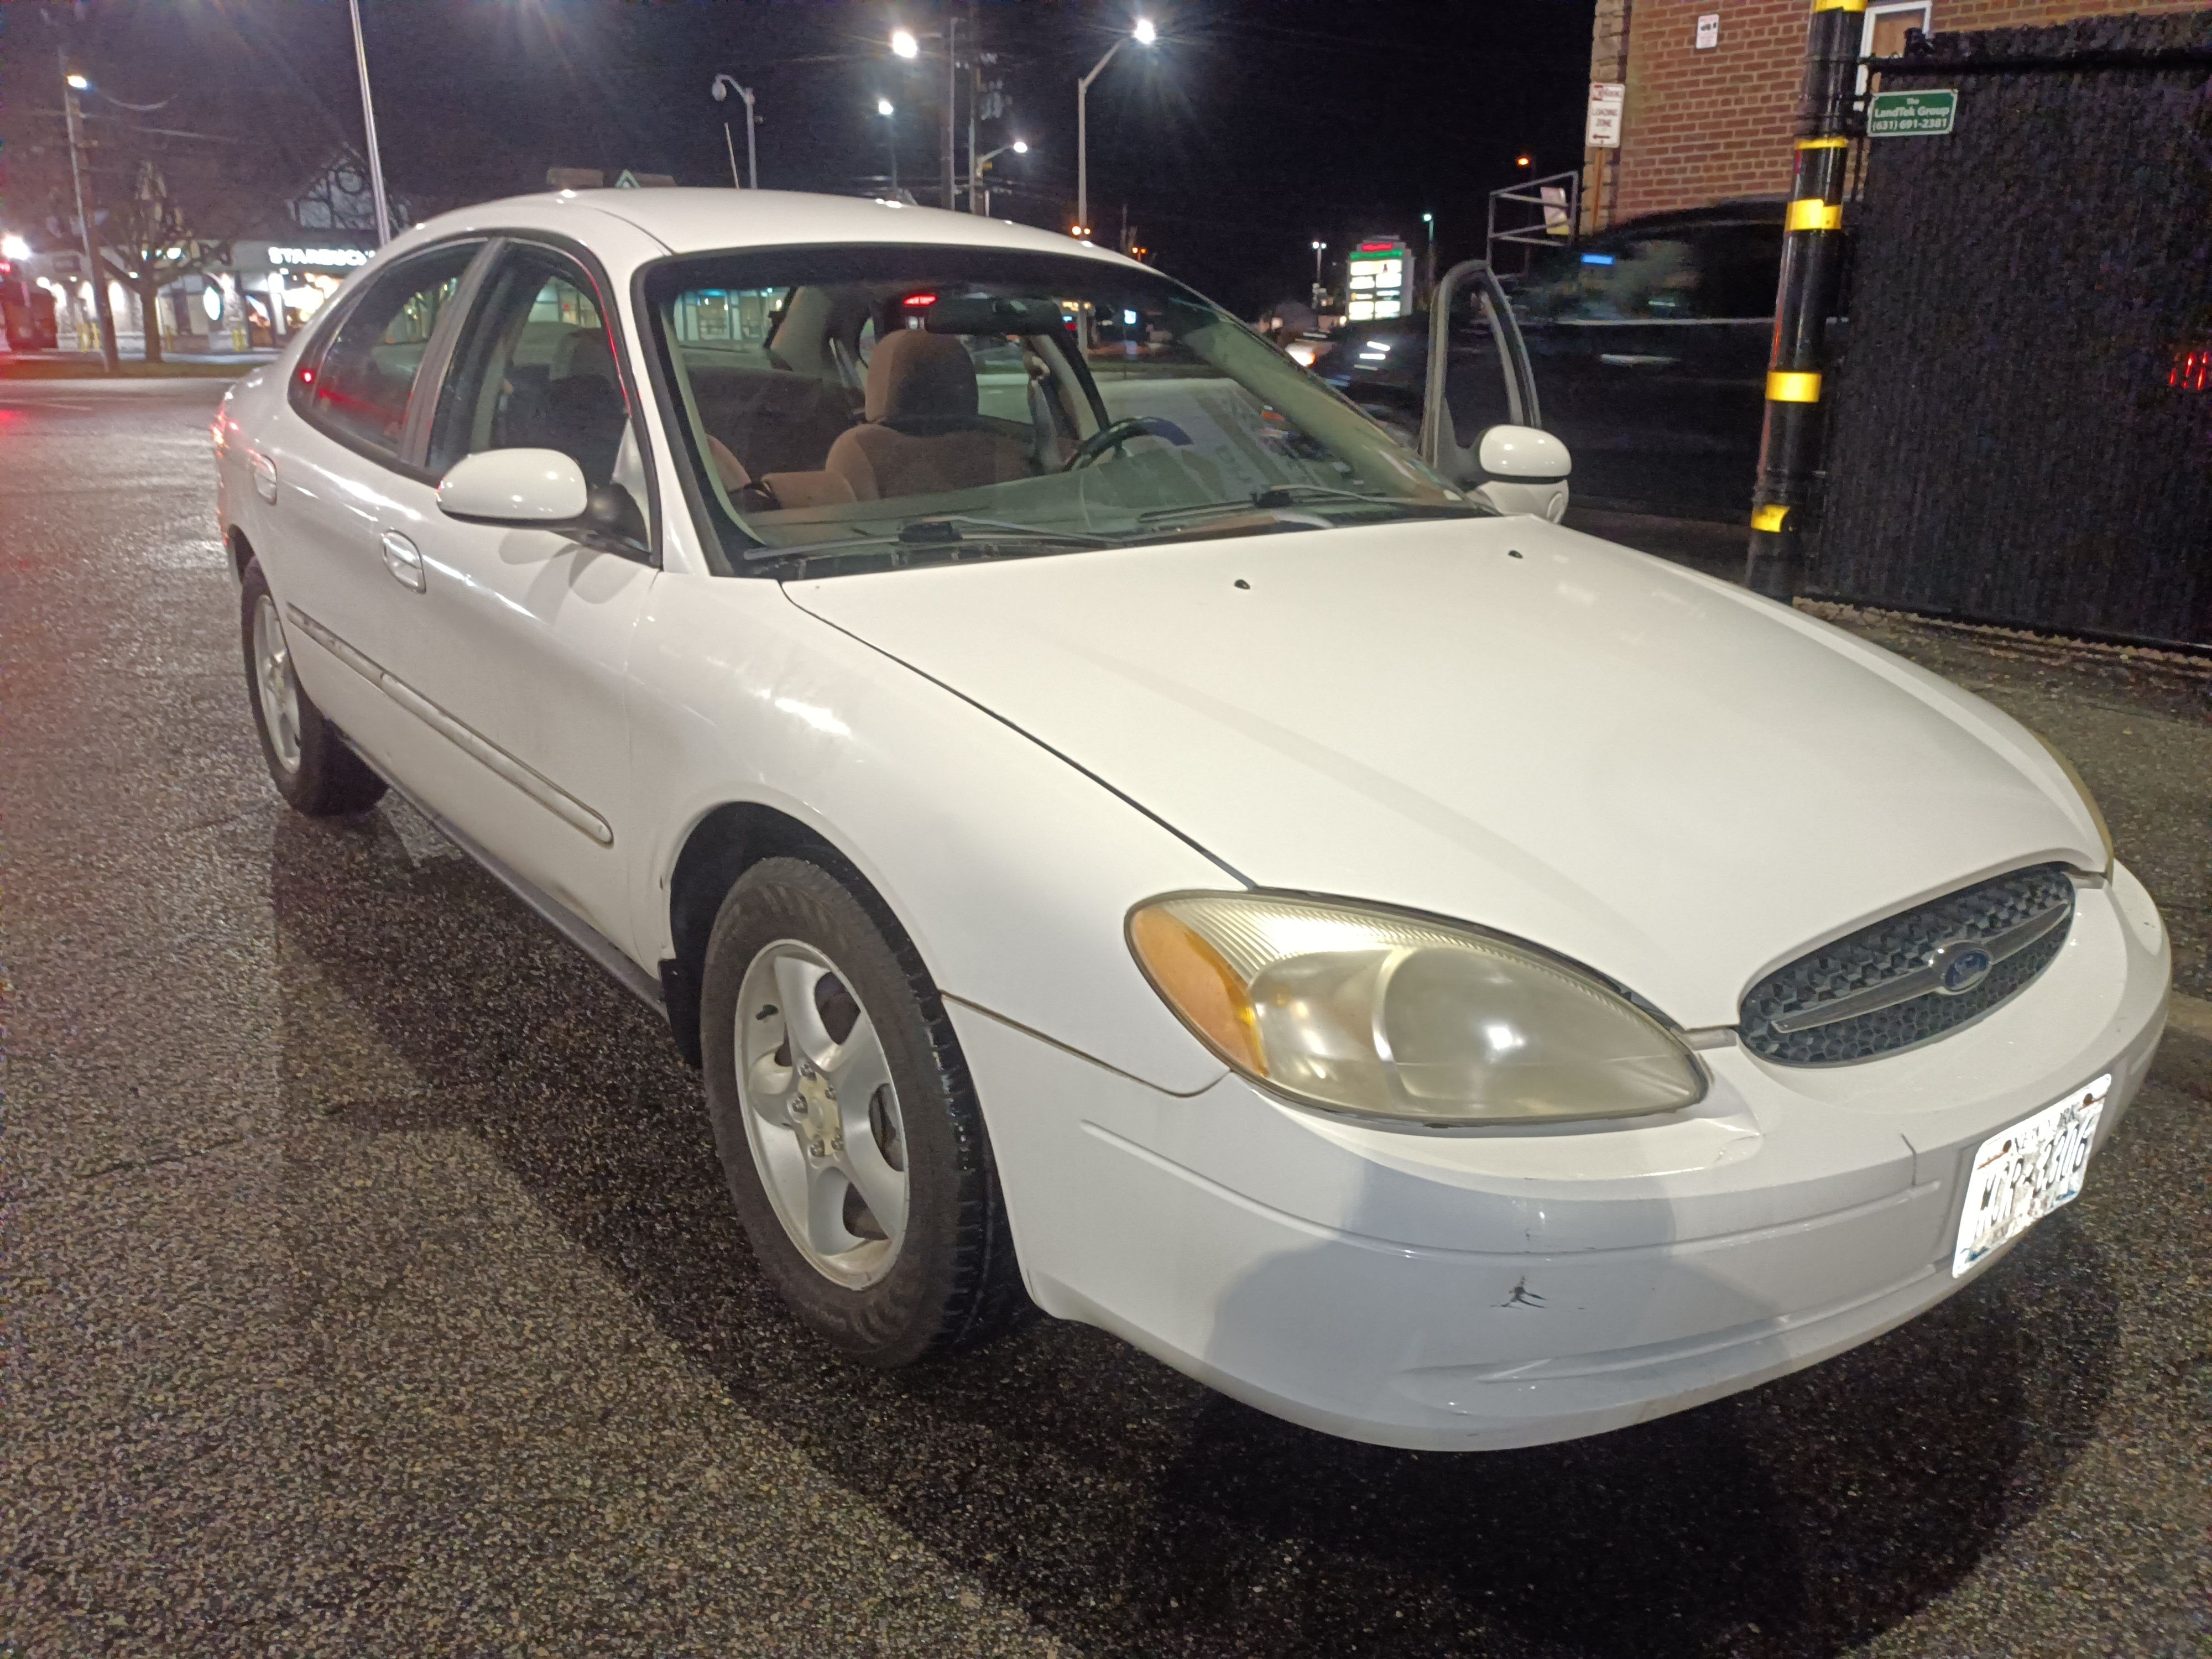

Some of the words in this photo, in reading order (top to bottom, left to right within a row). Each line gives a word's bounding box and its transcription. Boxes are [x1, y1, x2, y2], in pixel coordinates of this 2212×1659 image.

[1874, 106, 1915, 117] LandTek
[1917, 106, 1950, 117] Group
[1872, 120, 1898, 131] (631)
